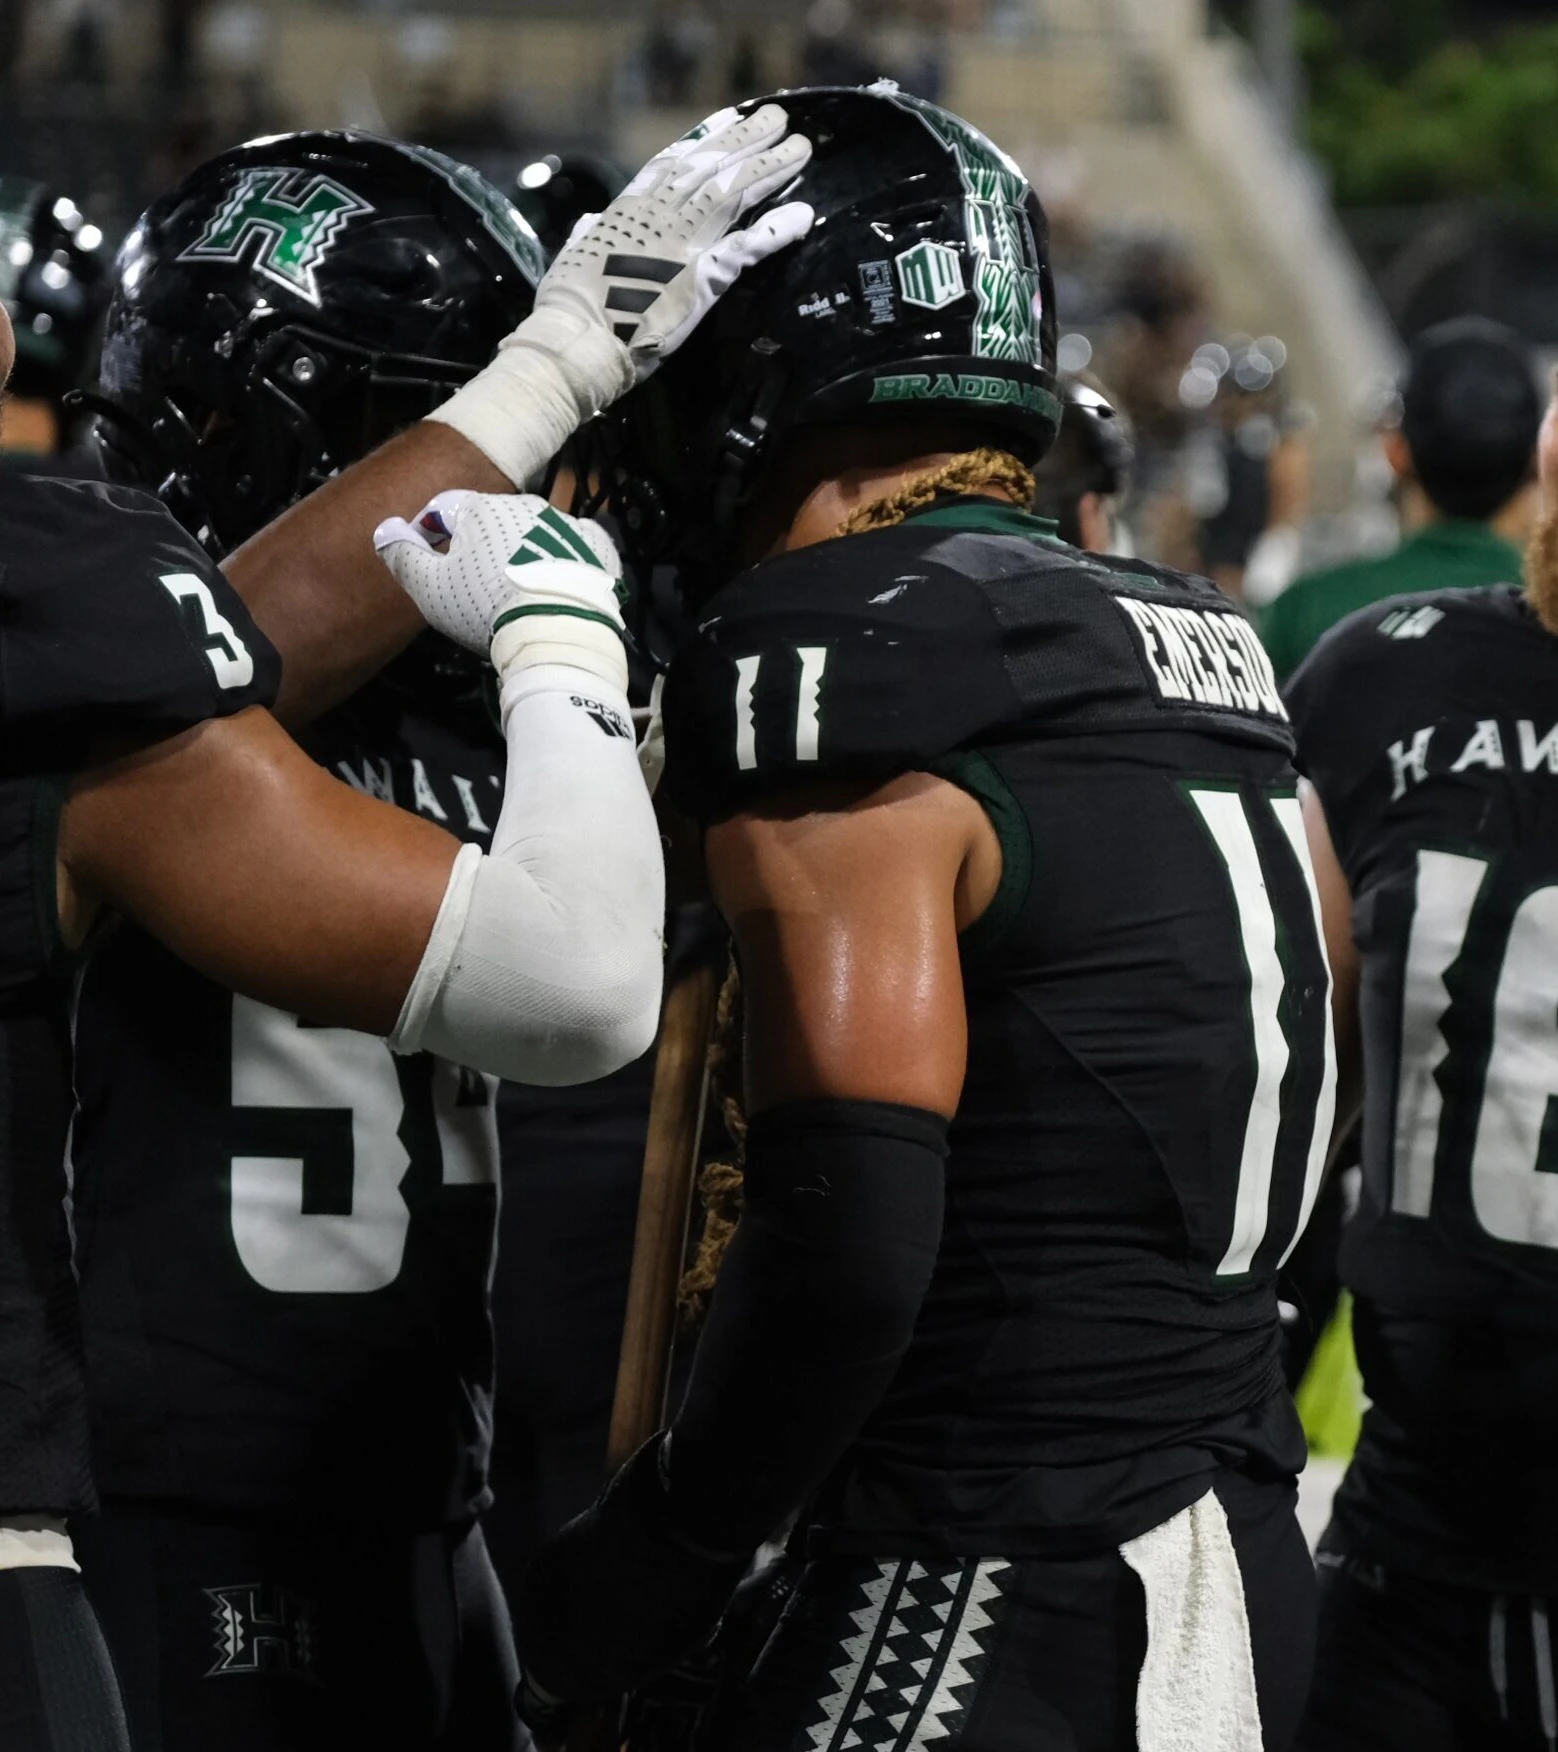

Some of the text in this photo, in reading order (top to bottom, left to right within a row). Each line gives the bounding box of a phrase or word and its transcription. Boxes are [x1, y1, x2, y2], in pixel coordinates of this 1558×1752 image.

[175, 166, 375, 308] H
[797, 291, 851, 317] Riddll
[160, 573, 254, 690] 3
[735, 646, 826, 770] 11
[1188, 789, 1338, 1276] 11
